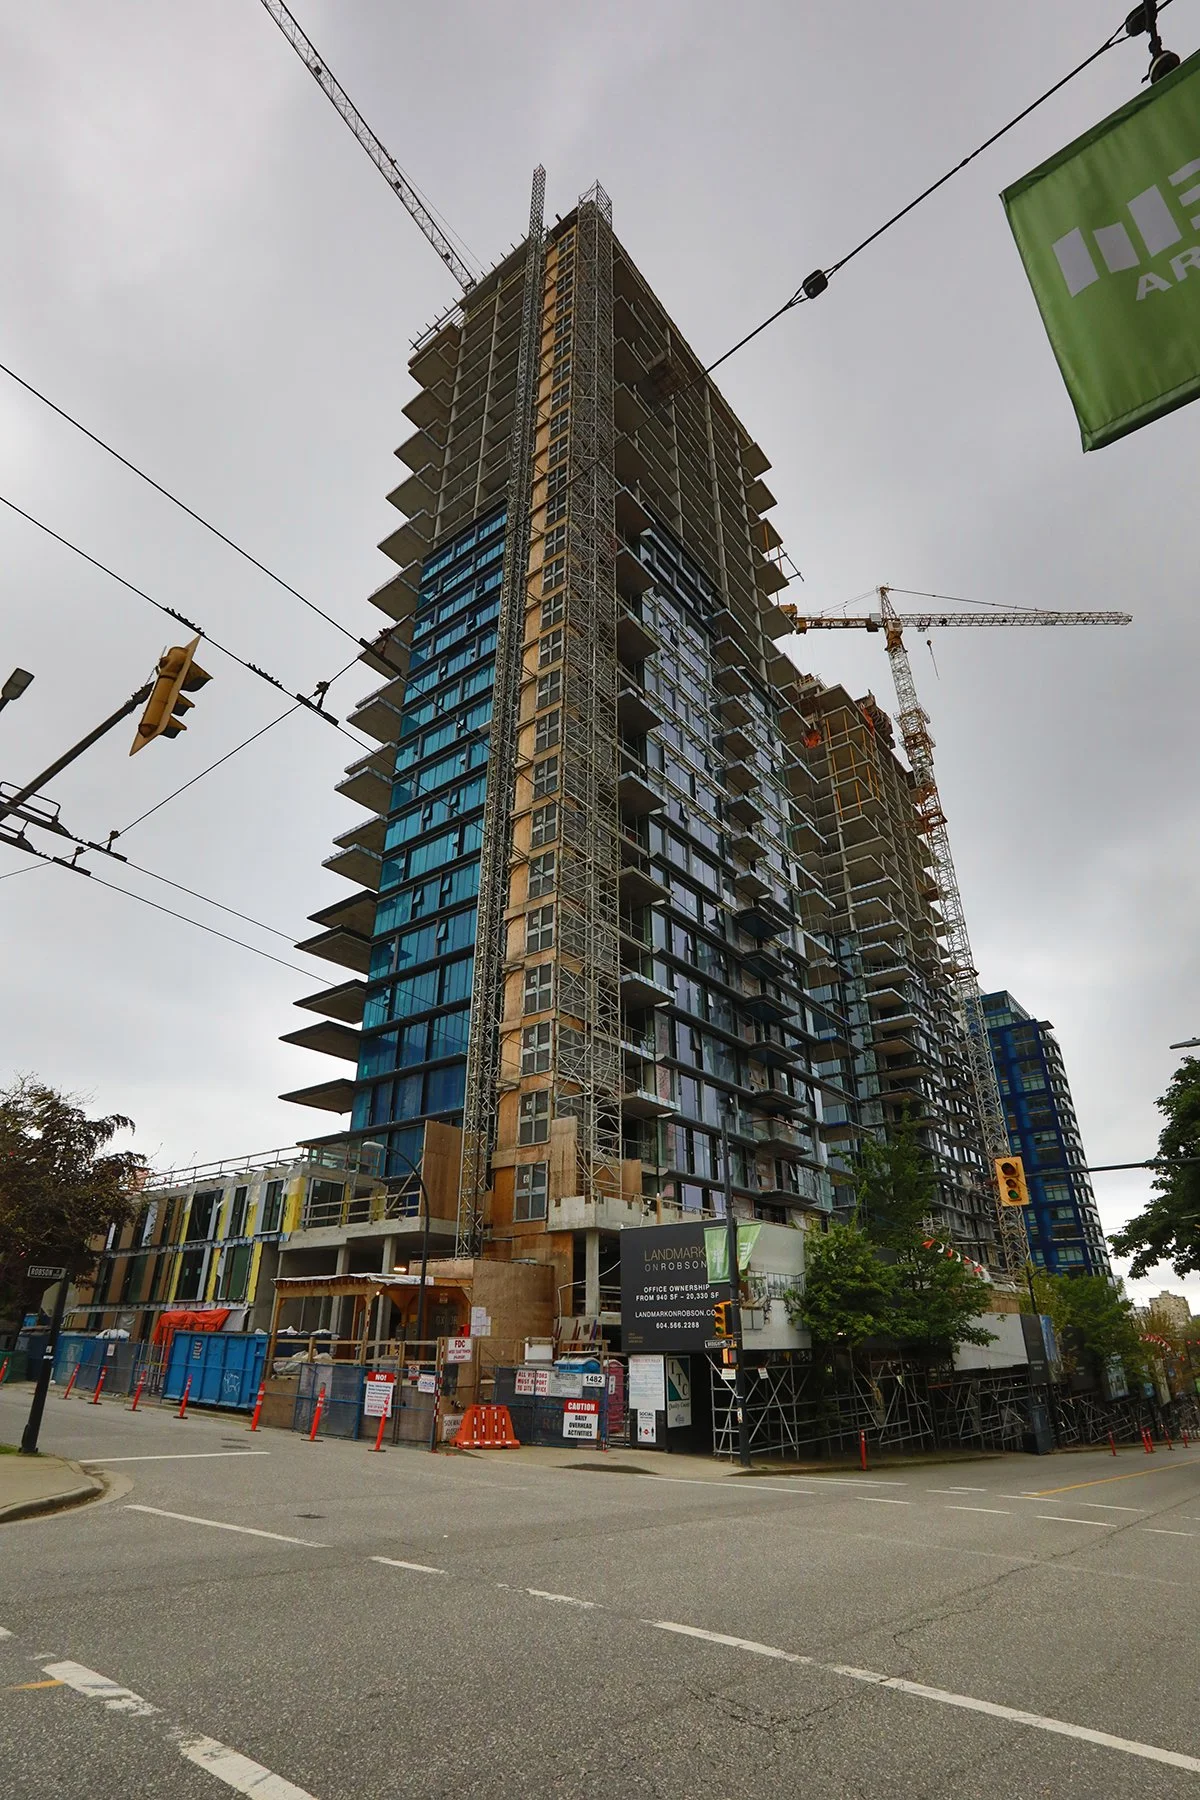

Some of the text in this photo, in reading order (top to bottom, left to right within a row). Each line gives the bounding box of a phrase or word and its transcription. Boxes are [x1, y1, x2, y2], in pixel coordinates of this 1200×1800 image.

[644, 1246, 706, 1262] LANDMARK
[643, 1283, 710, 1293] OFFICE OWNERSHIP
[686, 1292, 709, 1300] 20,330
[710, 1291, 720, 1299] SF
[635, 1309, 716, 1318] LANDMARKONROBSON.CO
[454, 1339, 466, 1348] FDC
[585, 1375, 603, 1383] 1482
[567, 1402, 595, 1411] CAUTION
